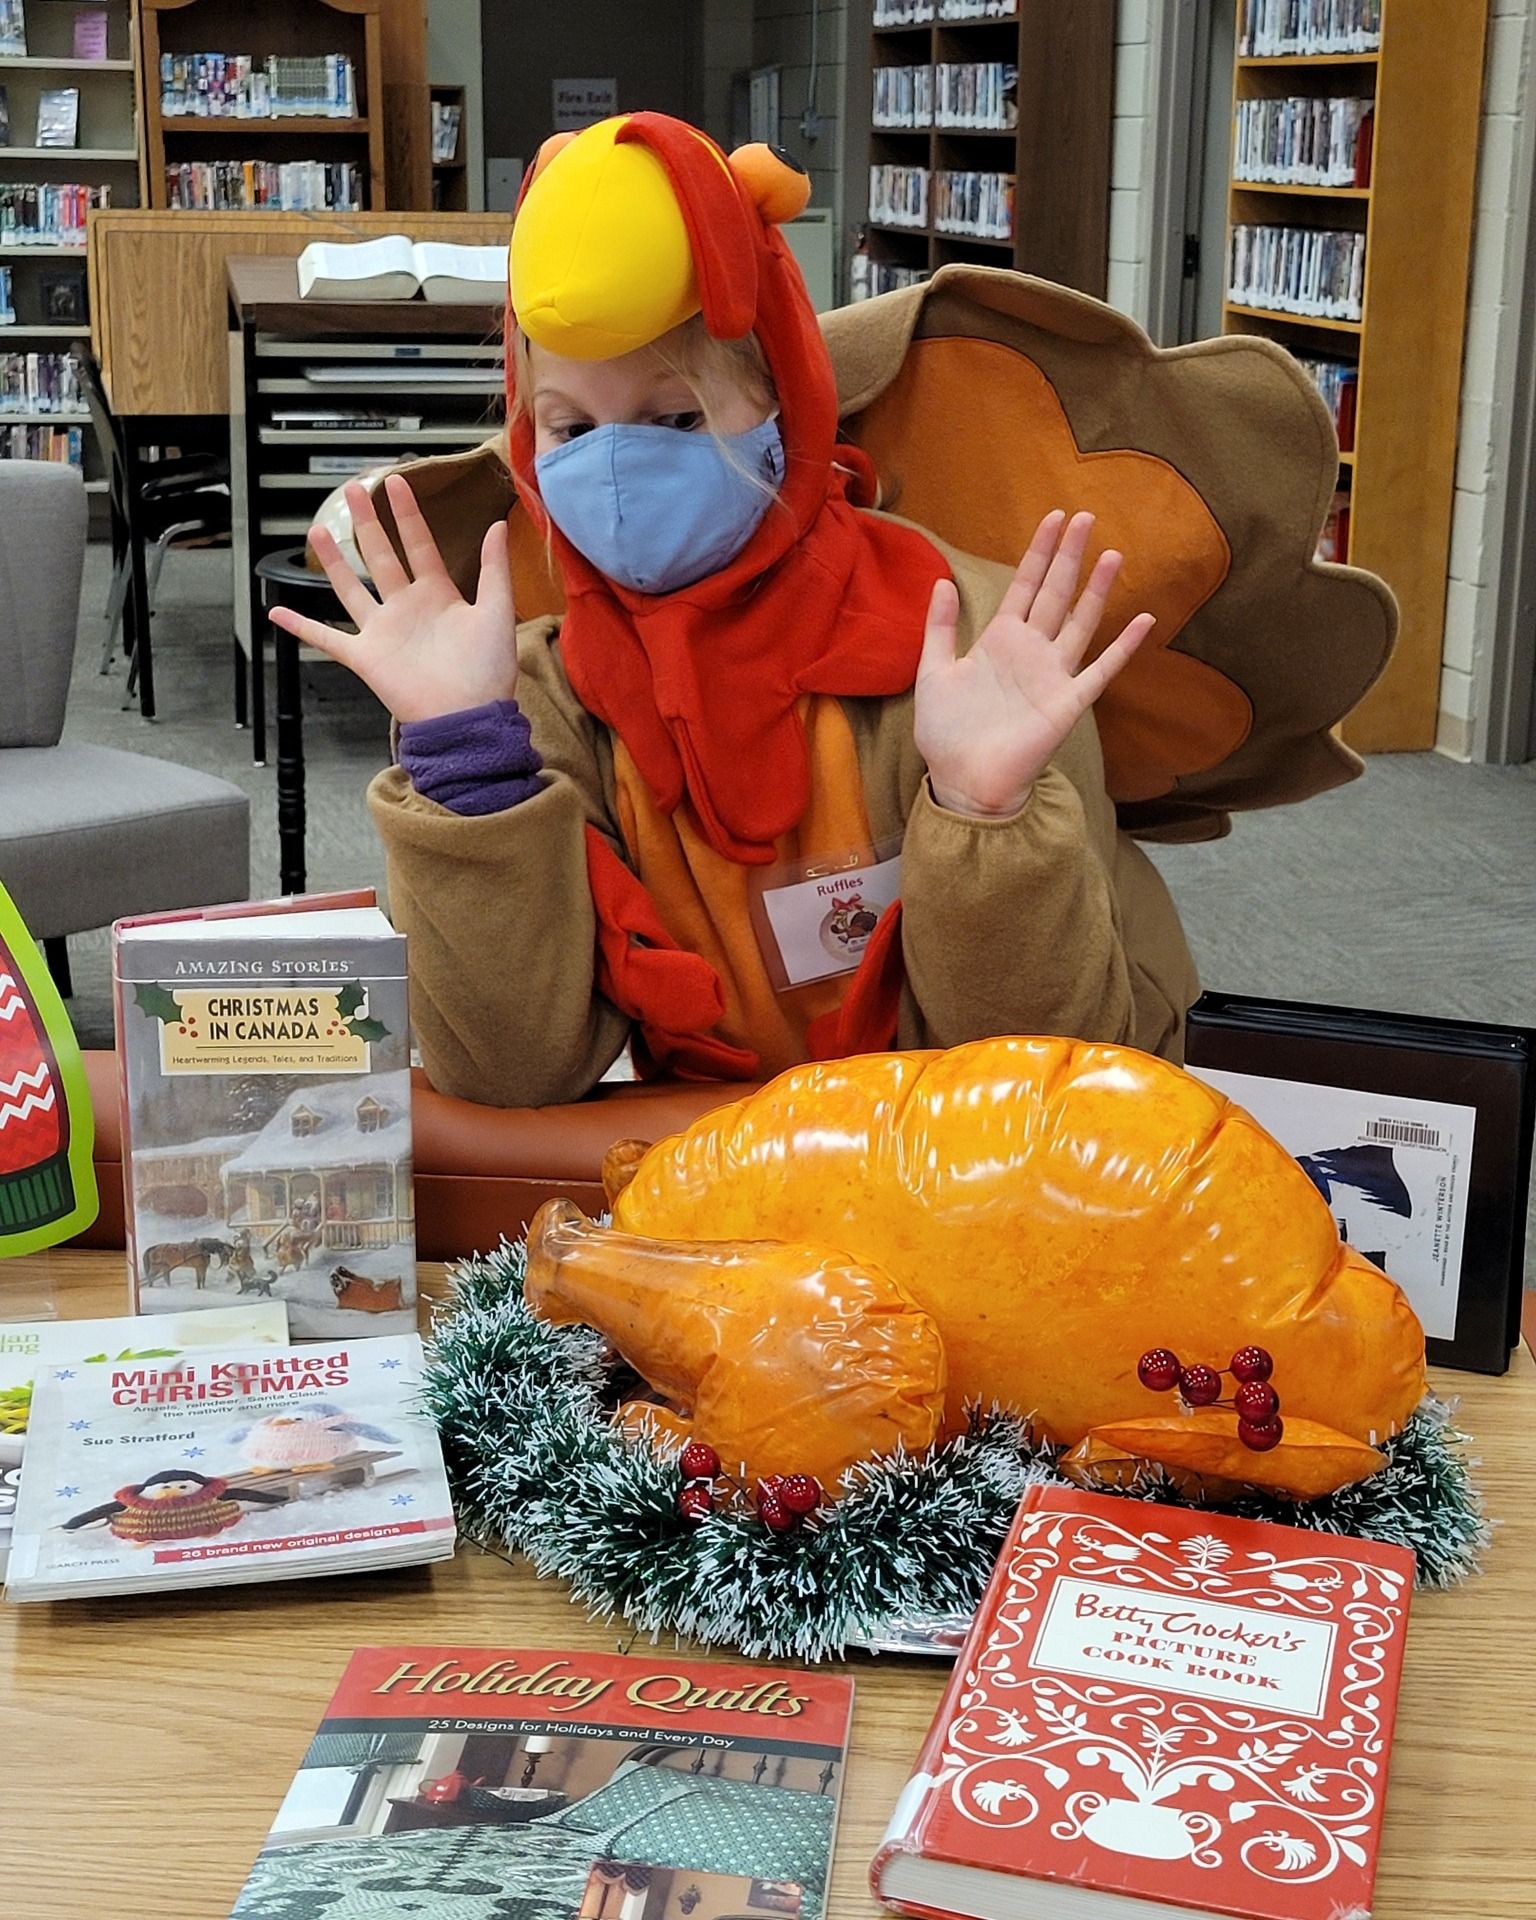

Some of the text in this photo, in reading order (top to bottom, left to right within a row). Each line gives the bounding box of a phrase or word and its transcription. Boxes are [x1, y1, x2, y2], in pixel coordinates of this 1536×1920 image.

[816, 876, 864, 897] Ruffles
[175, 960, 263, 975] AMAZING
[207, 998, 319, 1017] CHRISTMAS
[209, 1021, 320, 1040] IN CANADA
[172, 1055, 230, 1065] Heartwarming
[299, 1054, 314, 1063] and
[317, 1054, 358, 1063] Traditions
[1432, 1176, 1447, 1262] JEANETTE WINTERSON
[112, 1351, 349, 1388] Mini Knitted
[112, 1370, 350, 1406] CHRISTMAS
[247, 1392, 285, 1402] Santa
[163, 1401, 300, 1418] the nativity and more
[82, 1431, 195, 1446] Sue Stratford
[181, 1526, 400, 1559] 26 brand new original designs
[1075, 1593, 1306, 1653] Betty Crocker's
[1111, 1631, 1258, 1667] PICTURE
[1082, 1646, 1283, 1691] COOK BOOK
[371, 1658, 811, 1718] Holiday Quilts
[427, 1719, 735, 1750] 25 Designs for Holidays and Every Day
